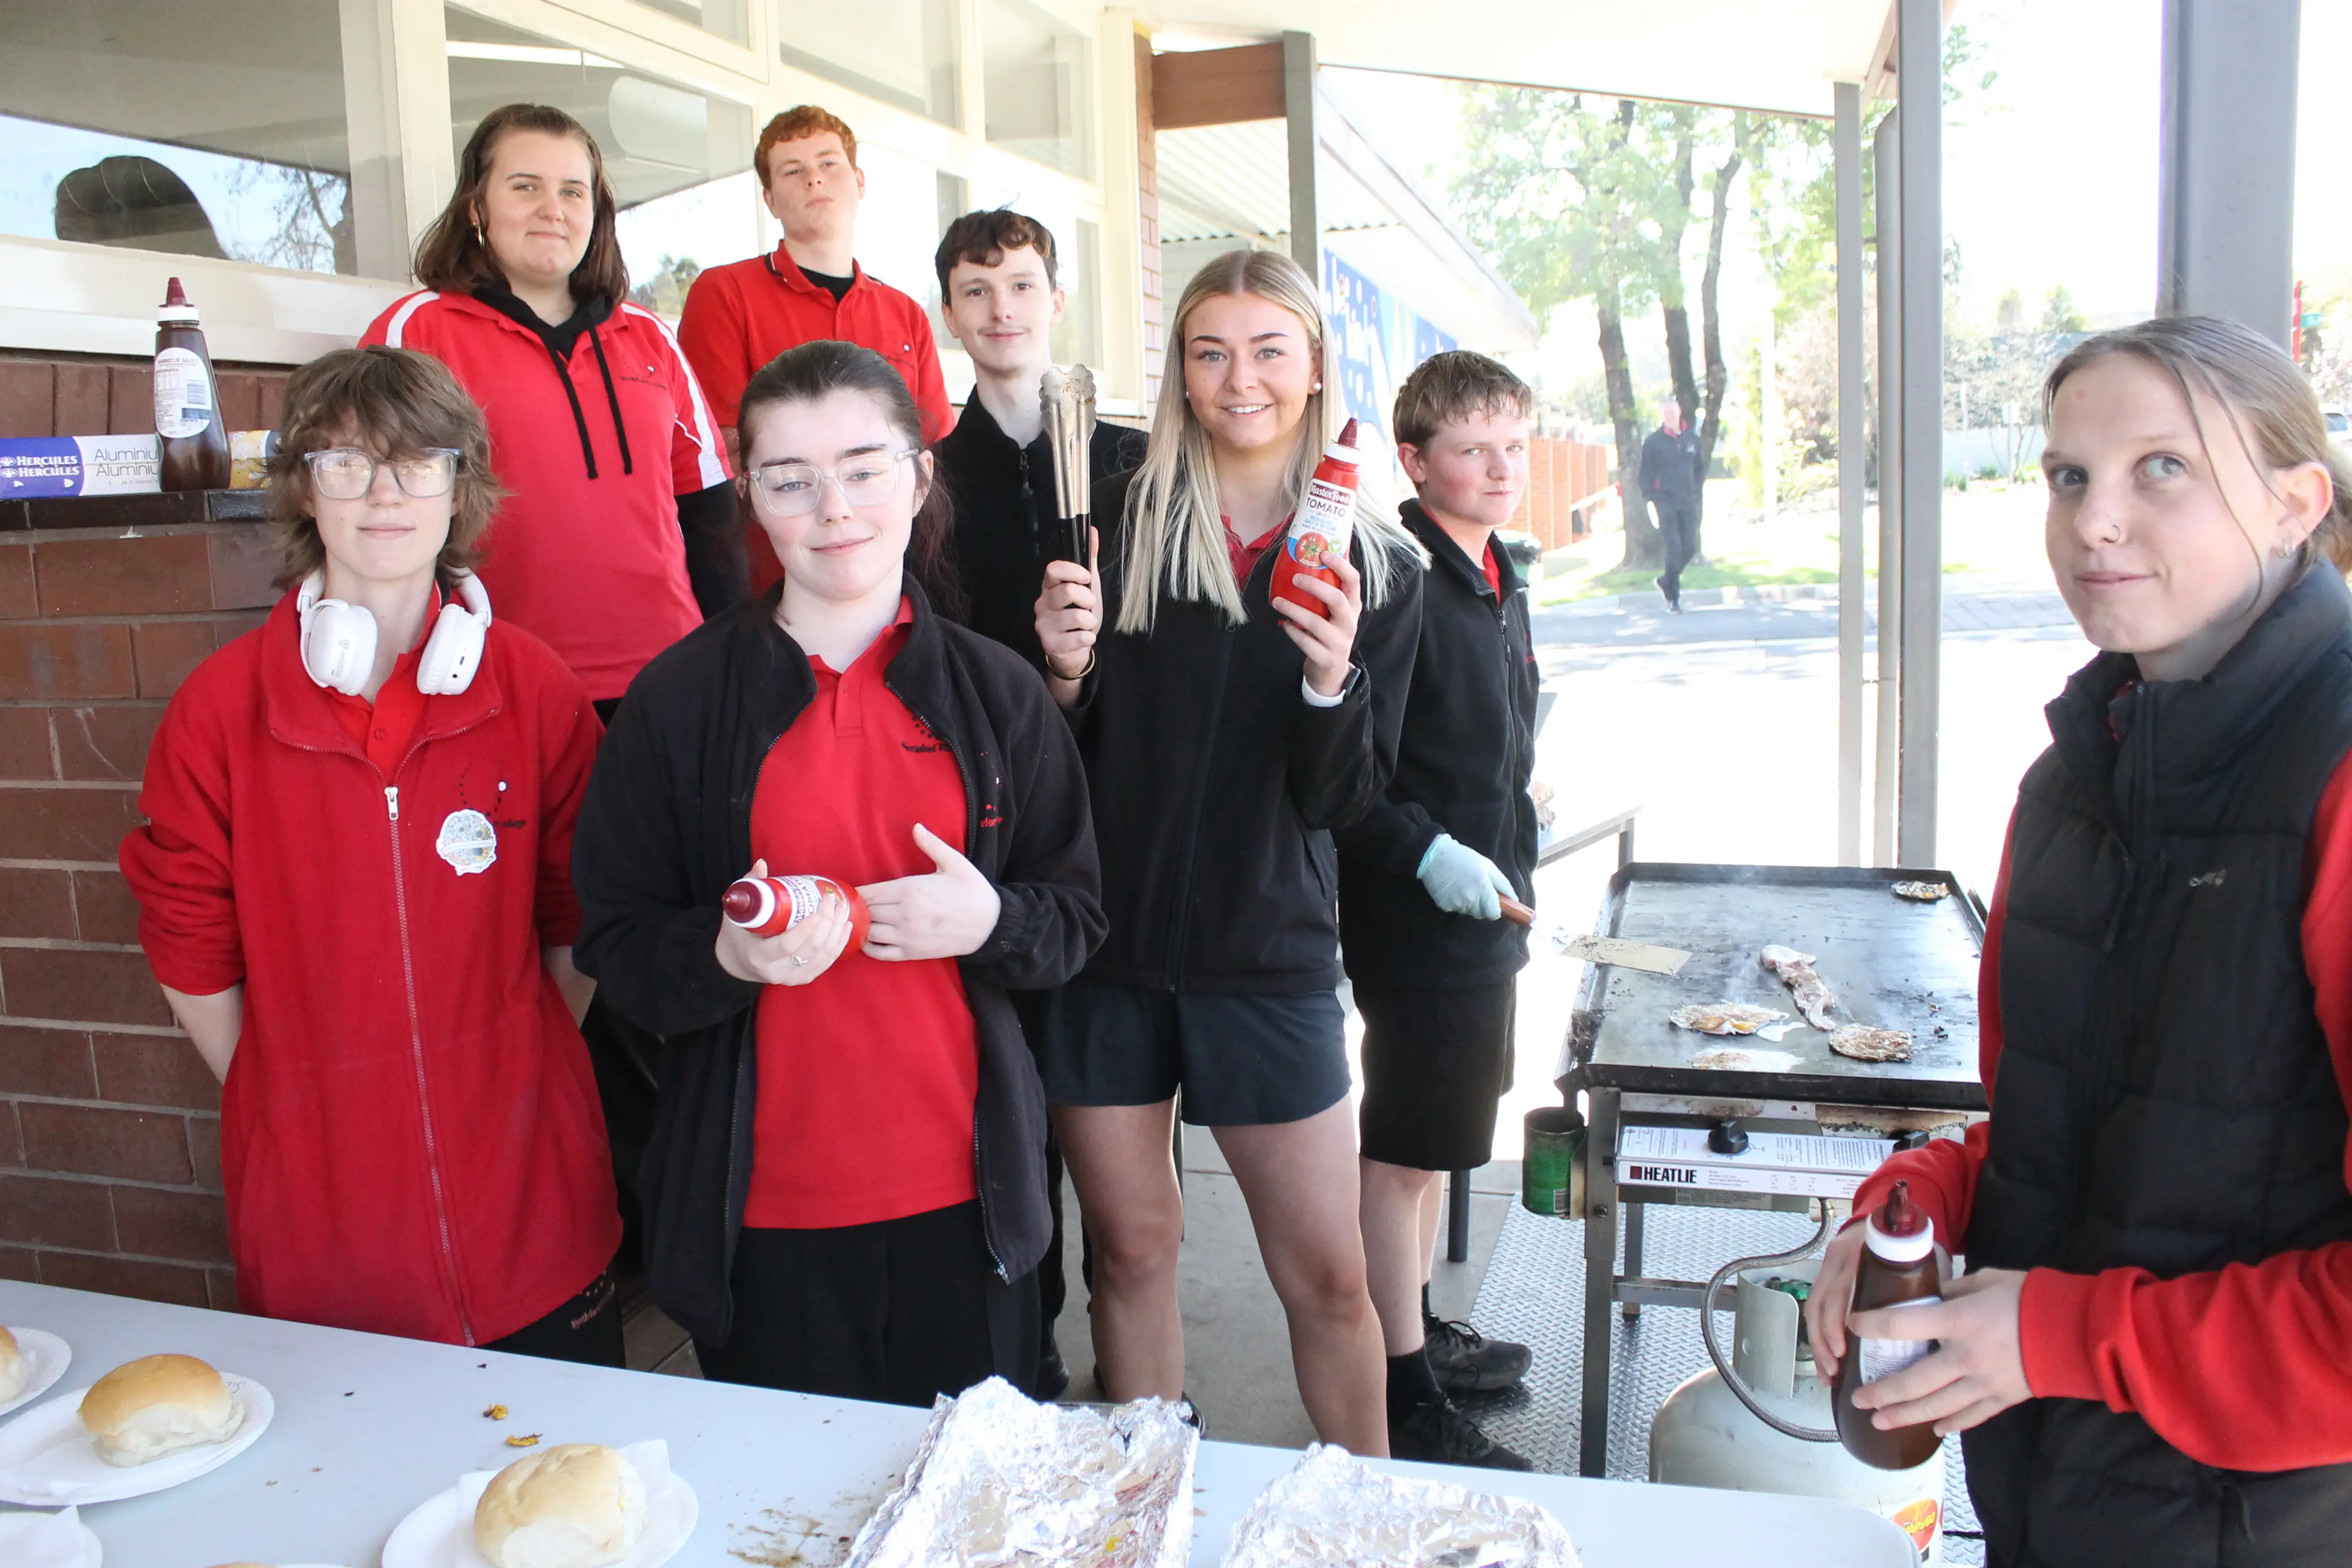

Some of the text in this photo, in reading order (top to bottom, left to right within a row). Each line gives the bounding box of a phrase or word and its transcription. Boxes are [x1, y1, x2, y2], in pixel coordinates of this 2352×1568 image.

[17, 455, 78, 467] HERCULES
[19, 467, 80, 477] HERCULES
[1306, 497, 1346, 517] TOMATO
[1644, 1166, 1697, 1184] HEATLIE
